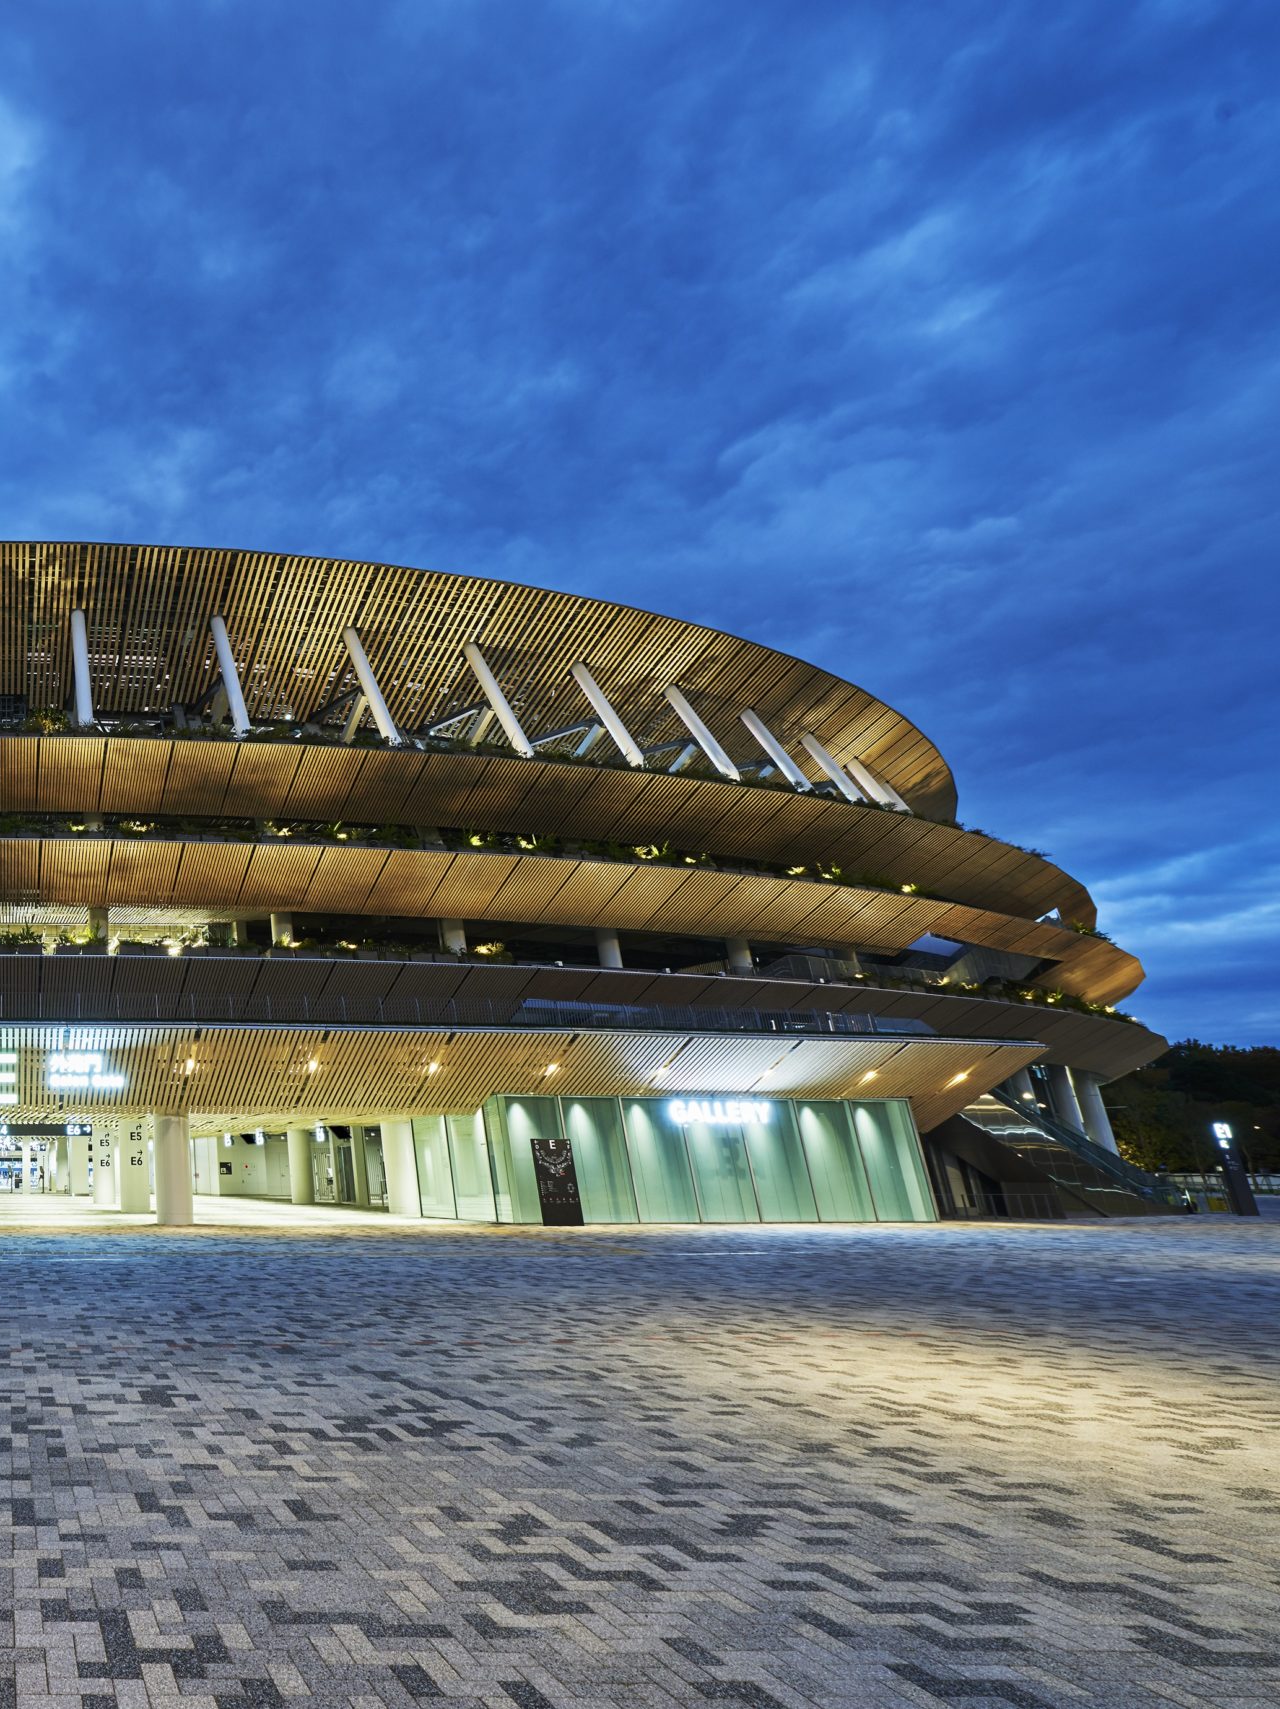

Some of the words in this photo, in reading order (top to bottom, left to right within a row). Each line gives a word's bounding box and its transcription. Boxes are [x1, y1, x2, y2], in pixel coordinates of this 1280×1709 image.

[669, 1100, 771, 1124] GALLERY
[66, 1124, 81, 1136] E6
[1213, 1123, 1233, 1139] E1
[130, 1132, 142, 1141] E5
[99, 1139, 110, 1147] E5
[548, 1139, 557, 1150] E
[100, 1159, 111, 1167] E6
[130, 1156, 143, 1166] E6
